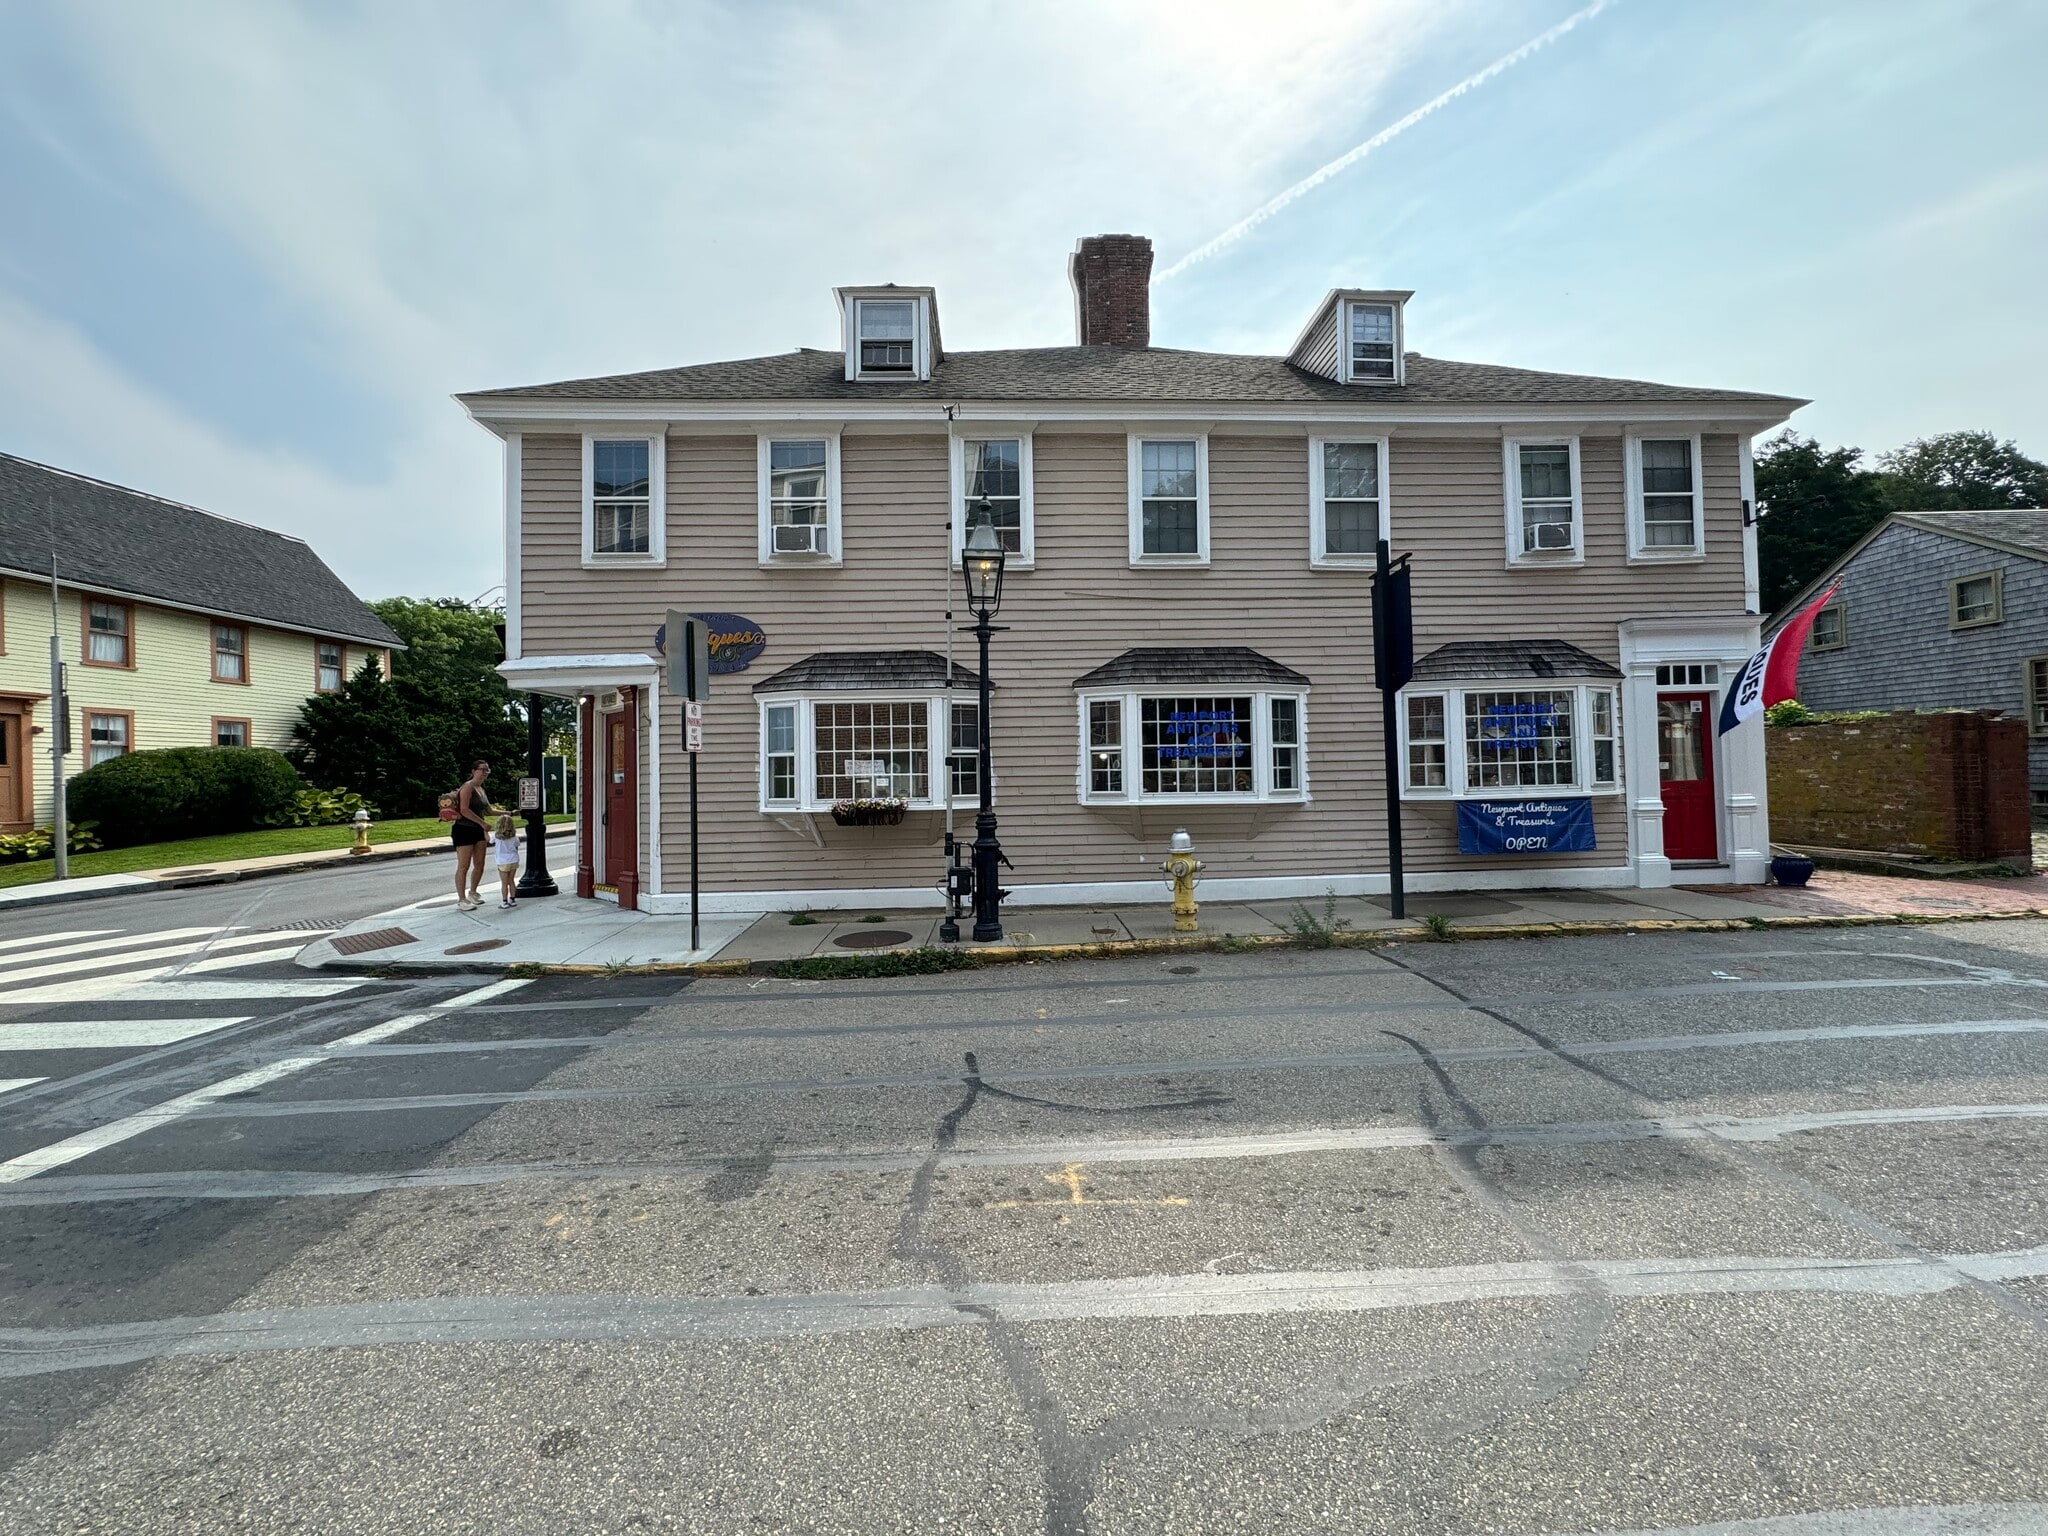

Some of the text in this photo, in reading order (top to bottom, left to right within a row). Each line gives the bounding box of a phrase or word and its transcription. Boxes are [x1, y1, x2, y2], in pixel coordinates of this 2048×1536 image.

[1488, 704, 1555, 714] NEWPORT
[1170, 711, 1235, 721] NEWPORT
[1484, 716, 1558, 728] ANTIQUES
[1166, 724, 1239, 734] ANTIQUES
[1510, 728, 1538, 738] AND
[1187, 736, 1214, 746] AND
[1481, 802, 1568, 818] Newport Antiques
[1495, 815, 1556, 827] & Treasures
[1506, 837, 1548, 850] OPEN
